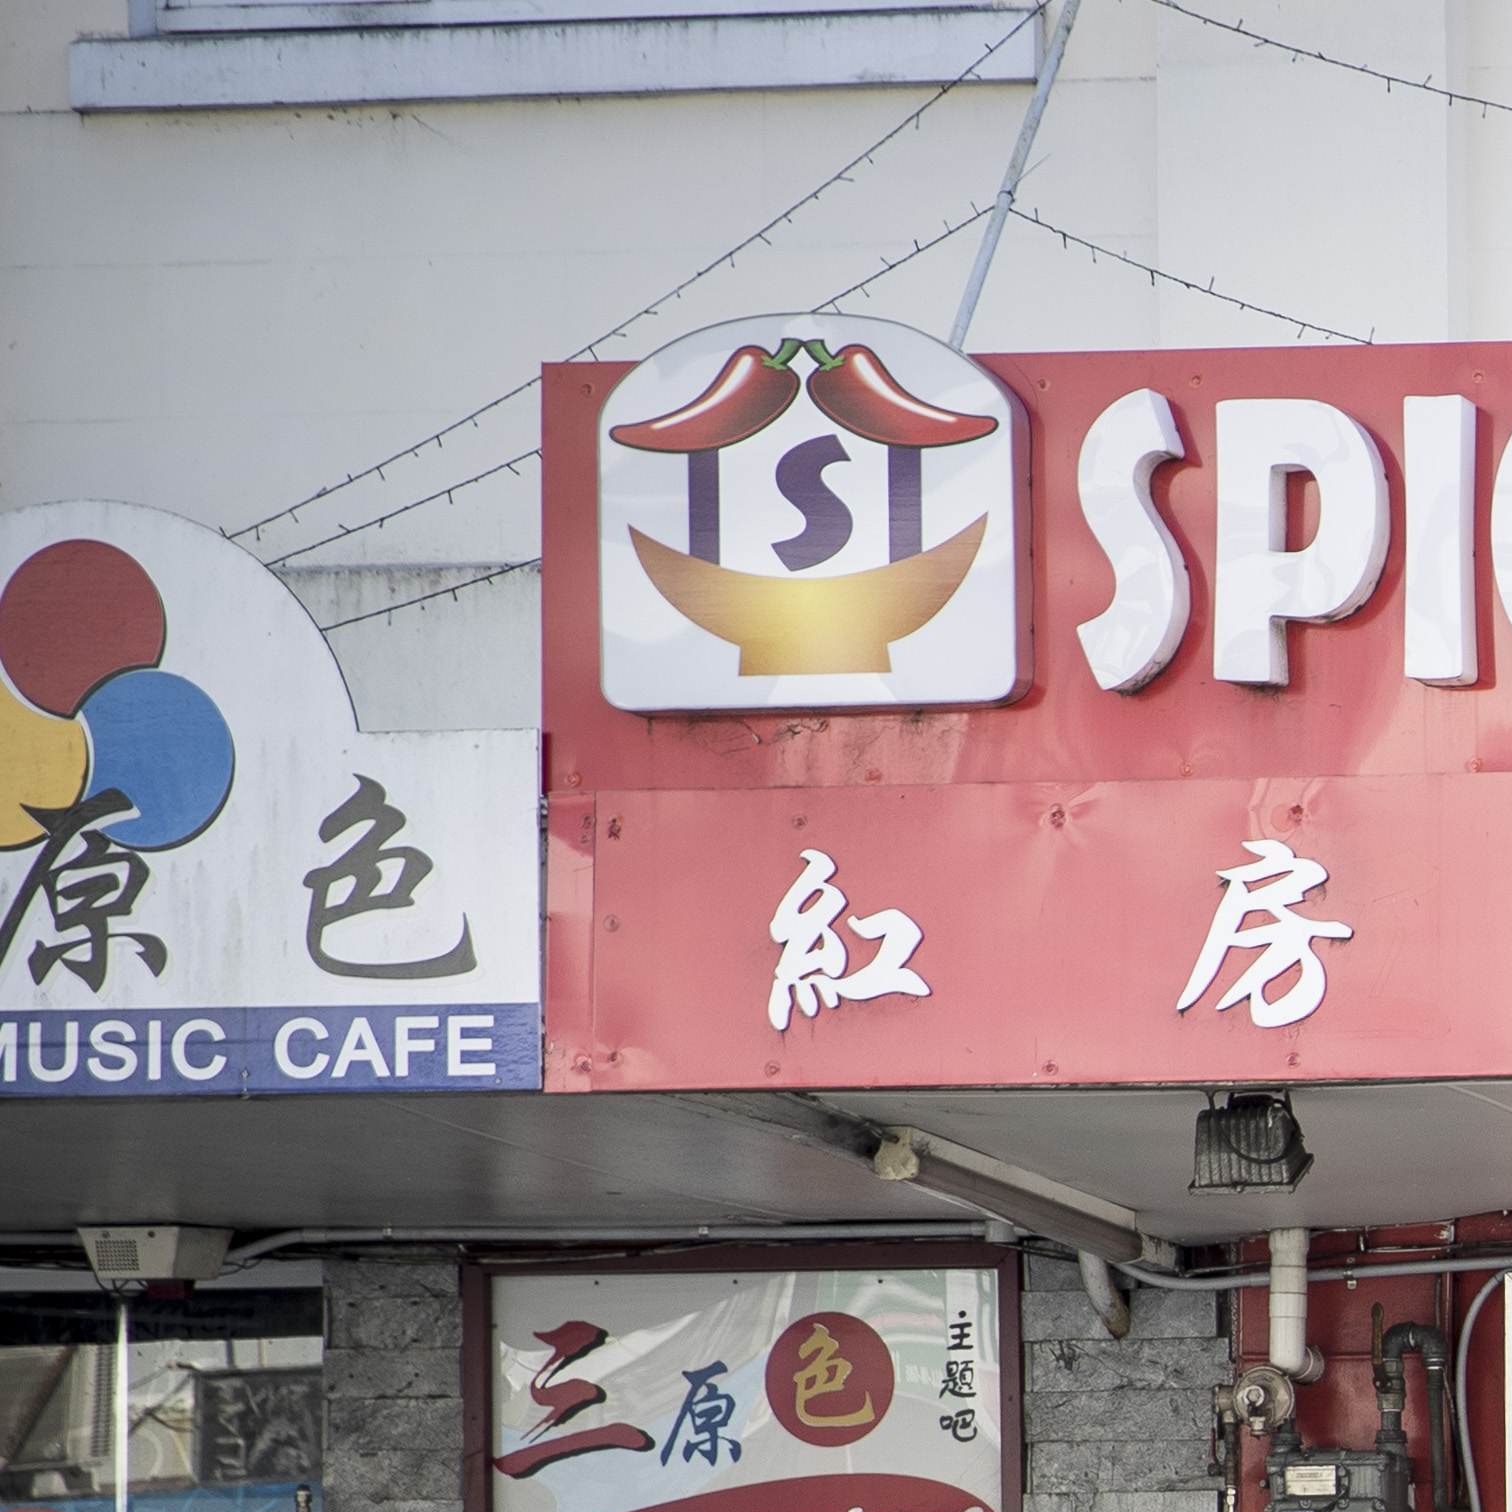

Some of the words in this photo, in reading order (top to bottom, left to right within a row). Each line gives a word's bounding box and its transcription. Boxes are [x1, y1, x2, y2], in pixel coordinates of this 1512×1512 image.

[273, 1014, 497, 1079] CAFE
[493, 1320, 876, 1479] 三原色
